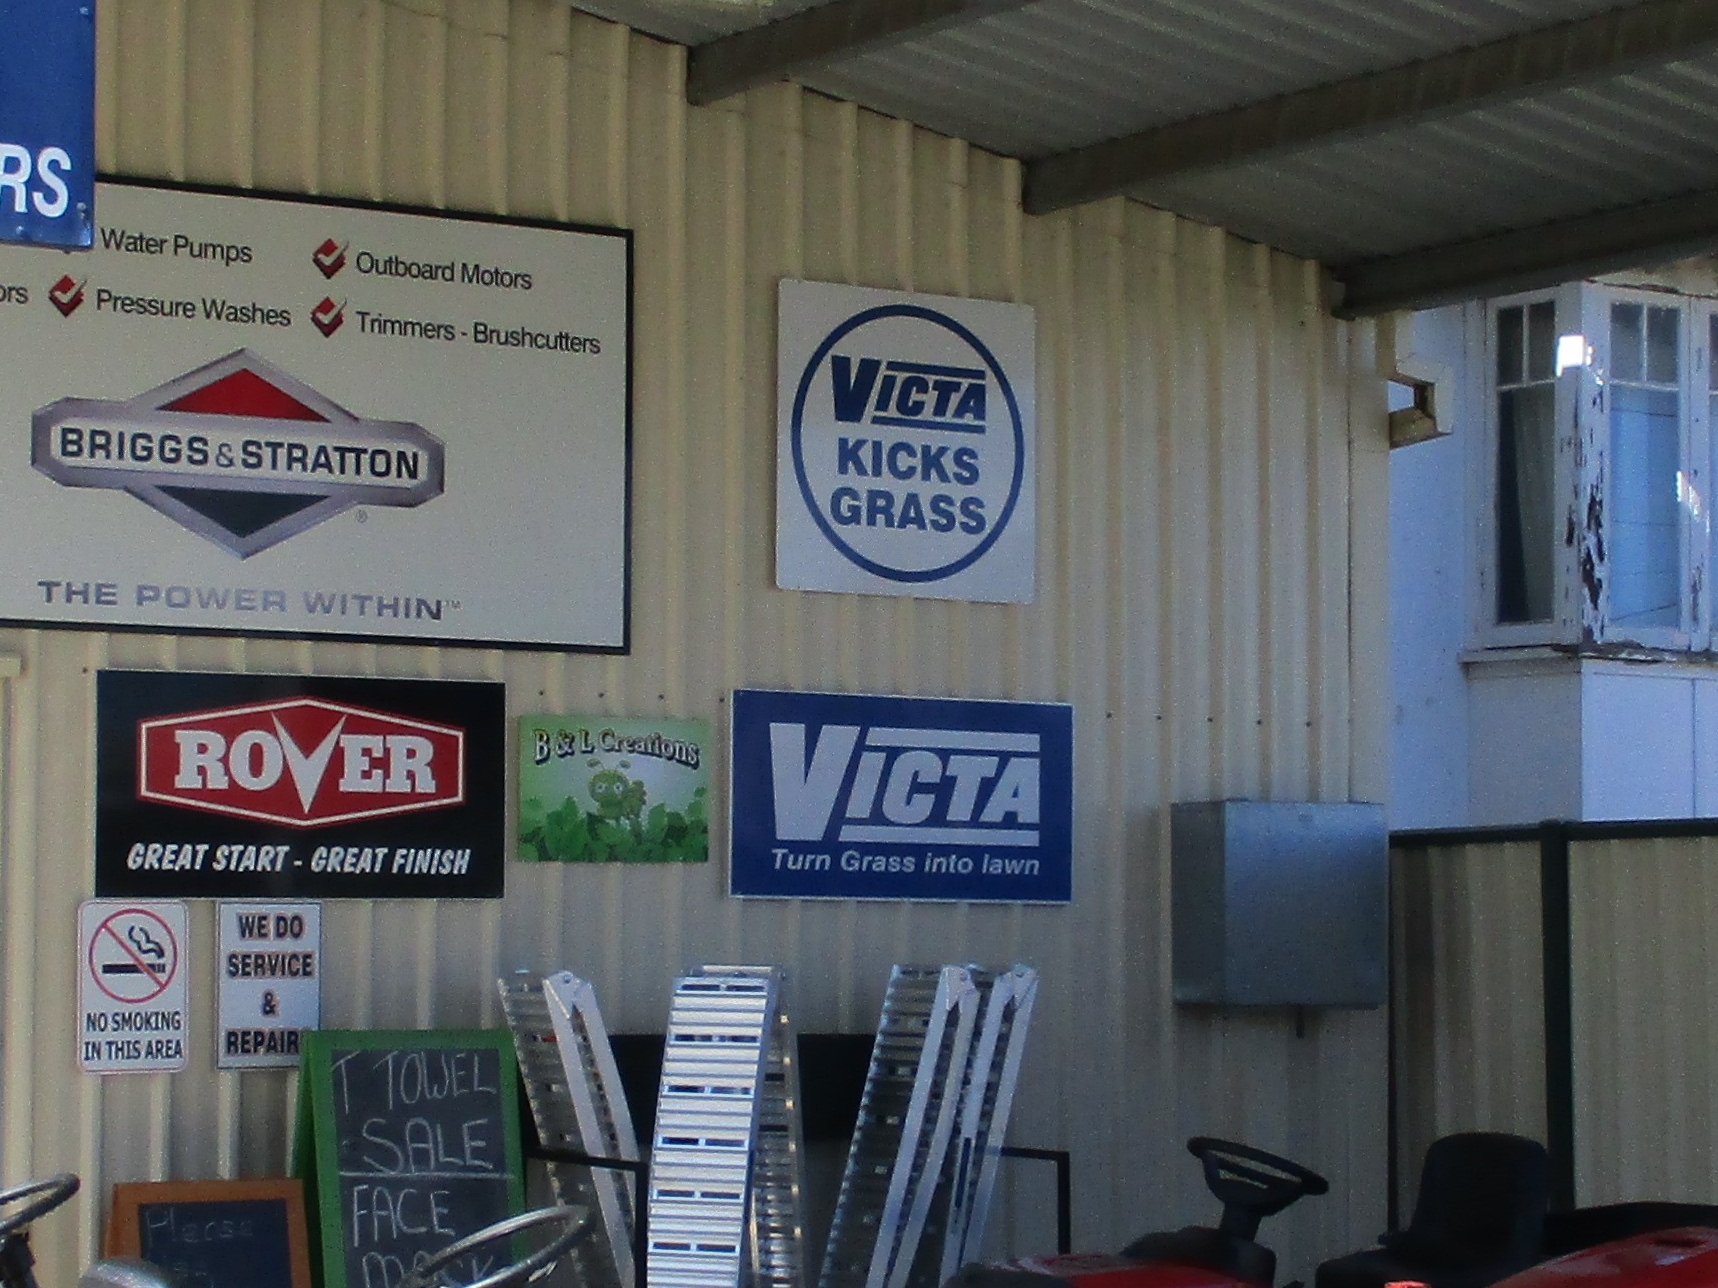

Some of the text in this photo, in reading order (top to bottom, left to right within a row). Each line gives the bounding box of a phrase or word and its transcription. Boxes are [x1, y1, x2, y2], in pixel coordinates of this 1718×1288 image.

[100, 227, 534, 291] Water Pumps Outboard Motors
[95, 288, 197, 321] Pressure
[201, 297, 292, 329] Washes
[355, 310, 456, 343] Trimmers
[473, 320, 602, 355] Brushcutters
[831, 355, 986, 425] VICTA
[837, 437, 980, 486] KICKS
[830, 487, 987, 535] GRASS
[37, 580, 443, 621] THE POWER WITHIN
[174, 713, 436, 815] ROVER
[533, 728, 700, 770] B & L Creations
[769, 721, 1040, 840] VICTA
[126, 843, 213, 870] GREAT
[211, 845, 290, 872] START
[310, 846, 389, 873] GREAT
[392, 848, 471, 876] FINISH
[771, 848, 1040, 876] Turn Grass into lawn
[239, 915, 304, 939] WE DO
[228, 953, 314, 978] SERVICE
[86, 1011, 182, 1031] NO SMOKING
[261, 991, 277, 1015] &
[83, 1039, 184, 1061] IN THIS AREA
[226, 1030, 301, 1054] REPAIR
[331, 1049, 498, 1114] T TOWEL
[361, 1117, 494, 1176] SALE
[352, 1185, 456, 1247] FACE
